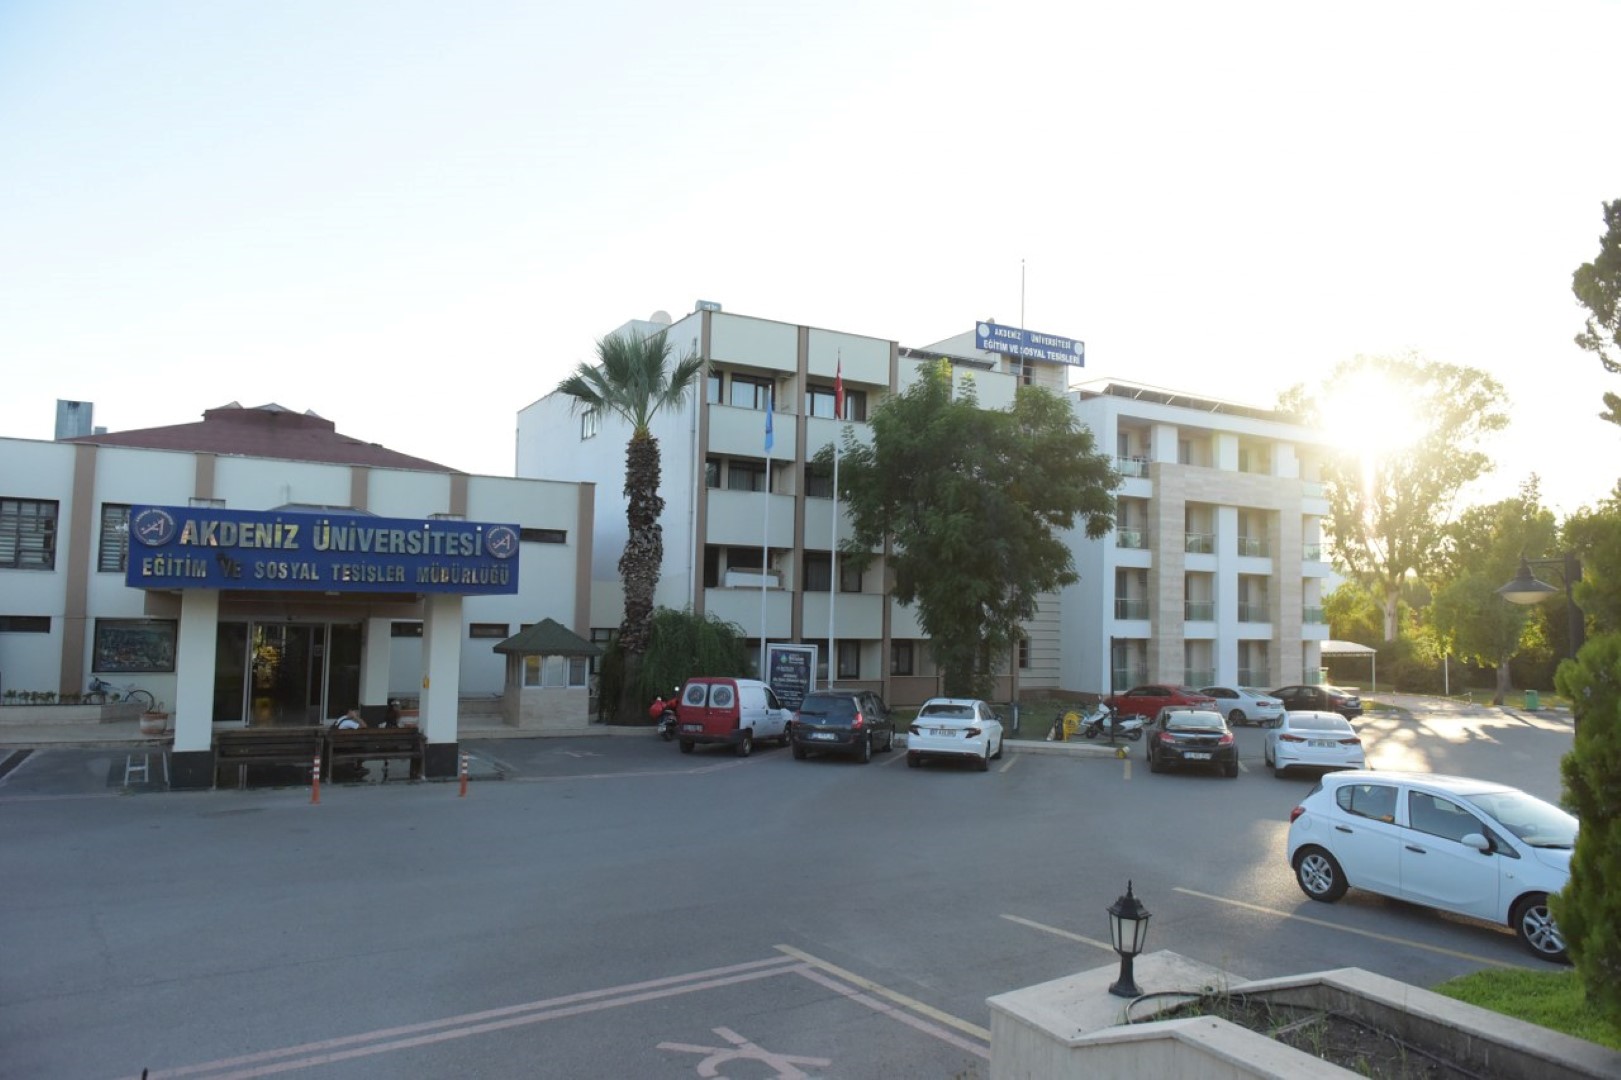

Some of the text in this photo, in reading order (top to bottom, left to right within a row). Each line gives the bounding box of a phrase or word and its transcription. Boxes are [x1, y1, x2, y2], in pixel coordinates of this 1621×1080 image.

[983, 338, 1009, 352] EĞİTİM
[1009, 343, 1019, 354] VE
[1047, 350, 1081, 365] TESİSLERİ
[179, 516, 300, 549] AKDENİZ
[313, 519, 482, 557] ÜNİVERSİTESİ
[142, 553, 510, 585] EĞİTİM VE SOSYAL TESİSLER MÜDÜRLÜĞÜ
